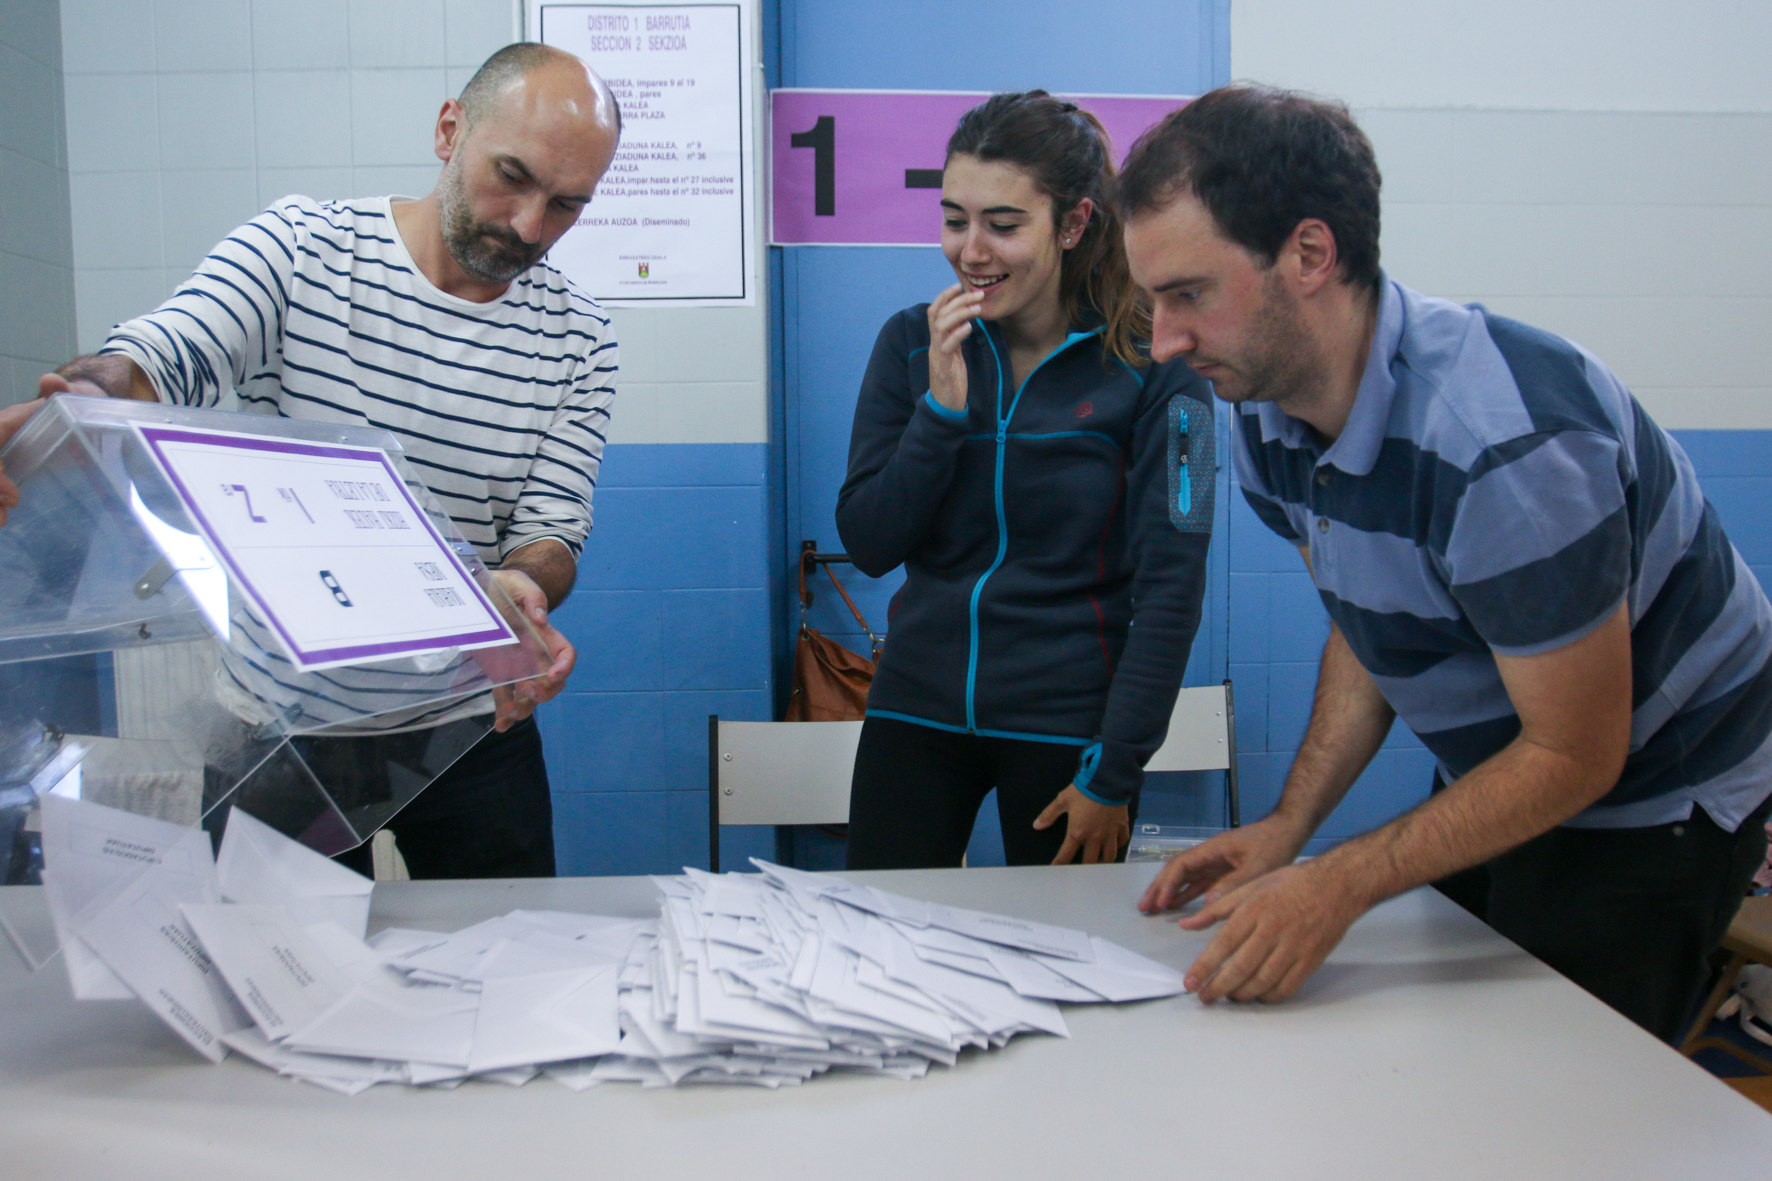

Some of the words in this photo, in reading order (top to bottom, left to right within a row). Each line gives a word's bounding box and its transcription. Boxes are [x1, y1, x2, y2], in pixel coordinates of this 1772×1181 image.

[588, 15, 629, 31] DISTRITO
[634, 16, 639, 31] 1
[646, 15, 691, 31] BARRUTIA
[591, 35, 632, 51] SECCION
[636, 35, 642, 51] 2
[648, 35, 687, 51] SEKZIOA
[637, 79, 668, 89] impares
[670, 79, 675, 87] 9
[677, 79, 684, 87] al
[687, 79, 696, 87] 19
[640, 91, 662, 99] pares
[623, 101, 649, 109] KALEA
[641, 111, 666, 119] PLAZA
[651, 142, 679, 150] KALEA,
[697, 141, 702, 149] 9
[697, 152, 707, 160] 36
[613, 164, 639, 172] KALEA
[791, 116, 835, 216] 1
[672, 176, 679, 184] el
[691, 176, 700, 184] 27
[702, 176, 734, 184] inclusive
[650, 187, 670, 196] hasta
[672, 187, 679, 196] el
[691, 187, 700, 195] 32
[702, 187, 734, 196] inclusive
[611, 218, 638, 226] AUZOA
[642, 217, 690, 227] (Diseminado)
[319, 570, 354, 607] B
